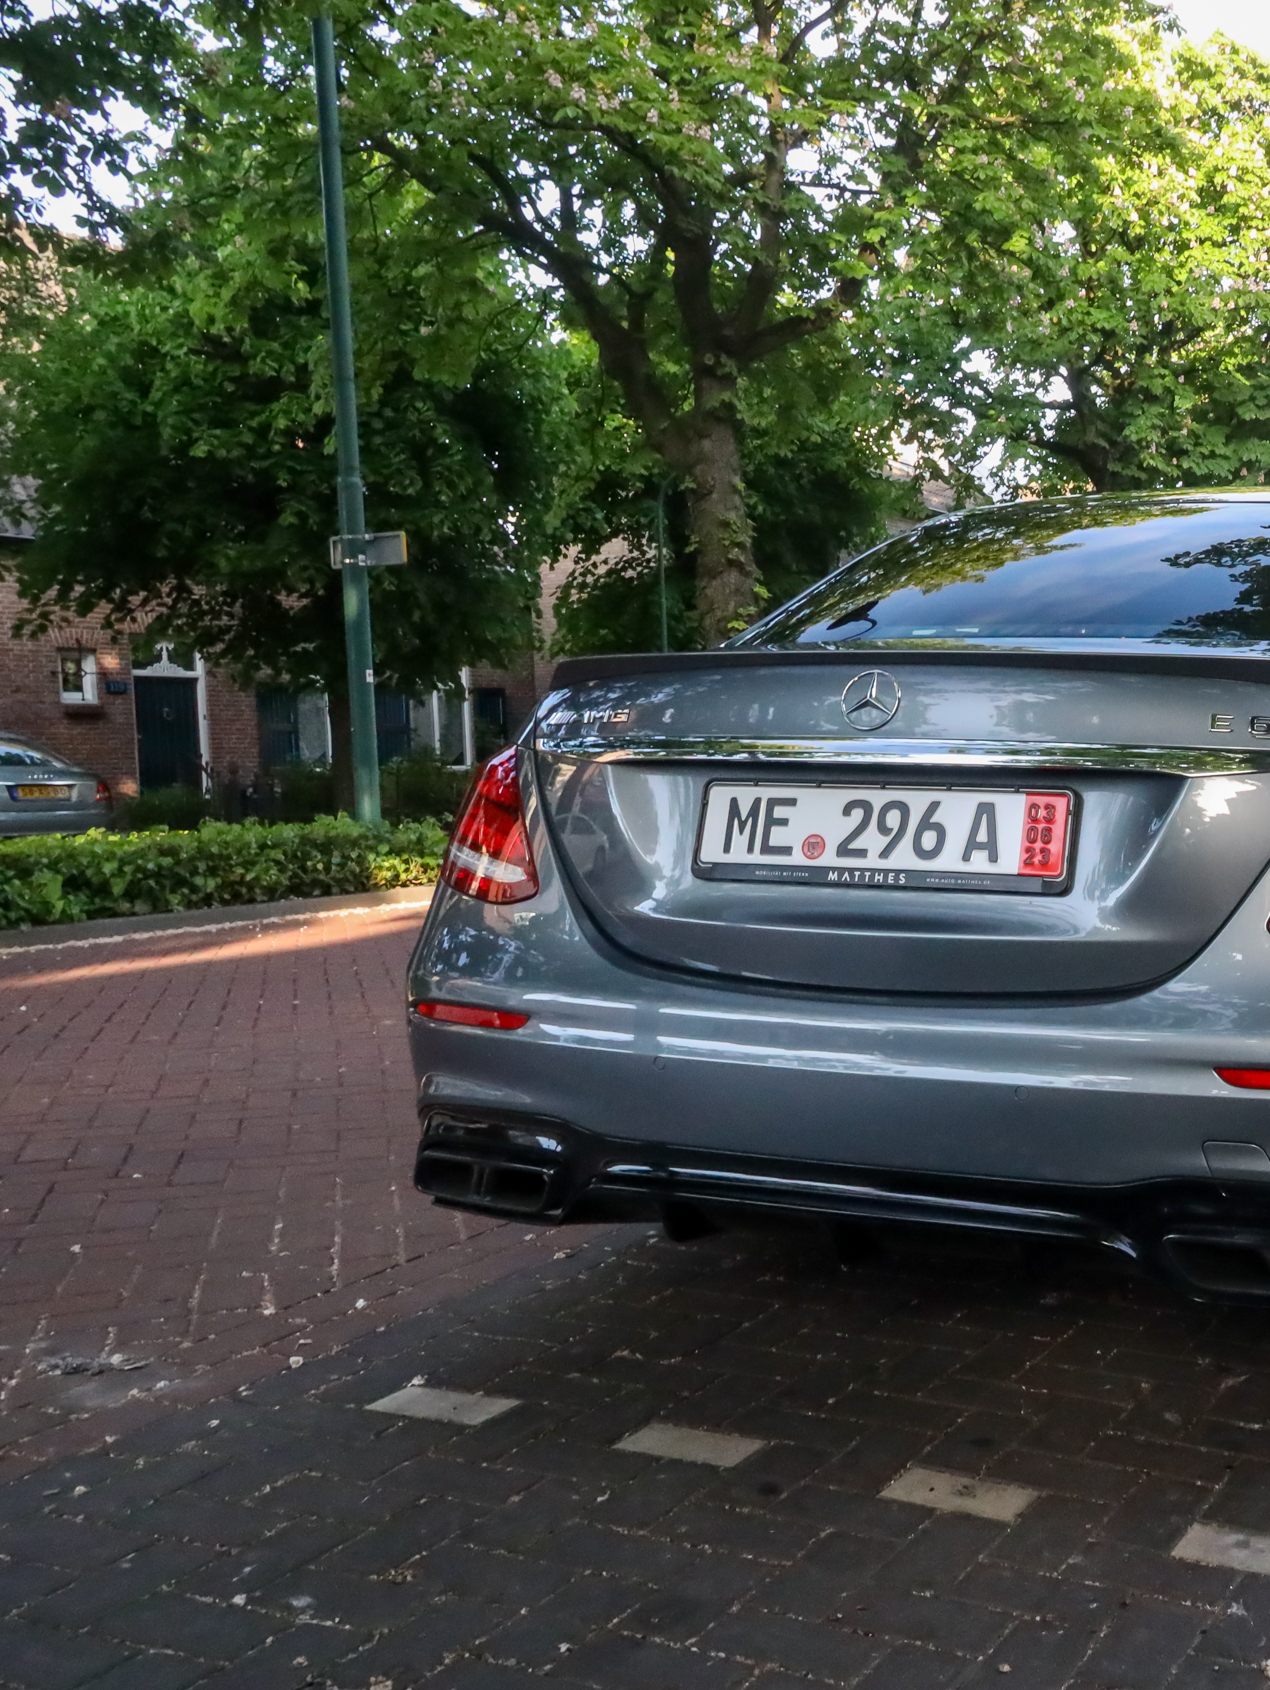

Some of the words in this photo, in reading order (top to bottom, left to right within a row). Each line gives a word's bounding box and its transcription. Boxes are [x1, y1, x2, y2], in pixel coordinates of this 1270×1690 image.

[569, 709, 630, 724] AMG
[1209, 713, 1234, 733] E
[1028, 803, 1056, 822] 03
[723, 797, 798, 857] ME
[836, 799, 948, 861] 296
[962, 802, 999, 863] A
[1026, 825, 1053, 845] 06
[1023, 847, 1051, 866] 23
[828, 870, 906, 885] MATTHES
